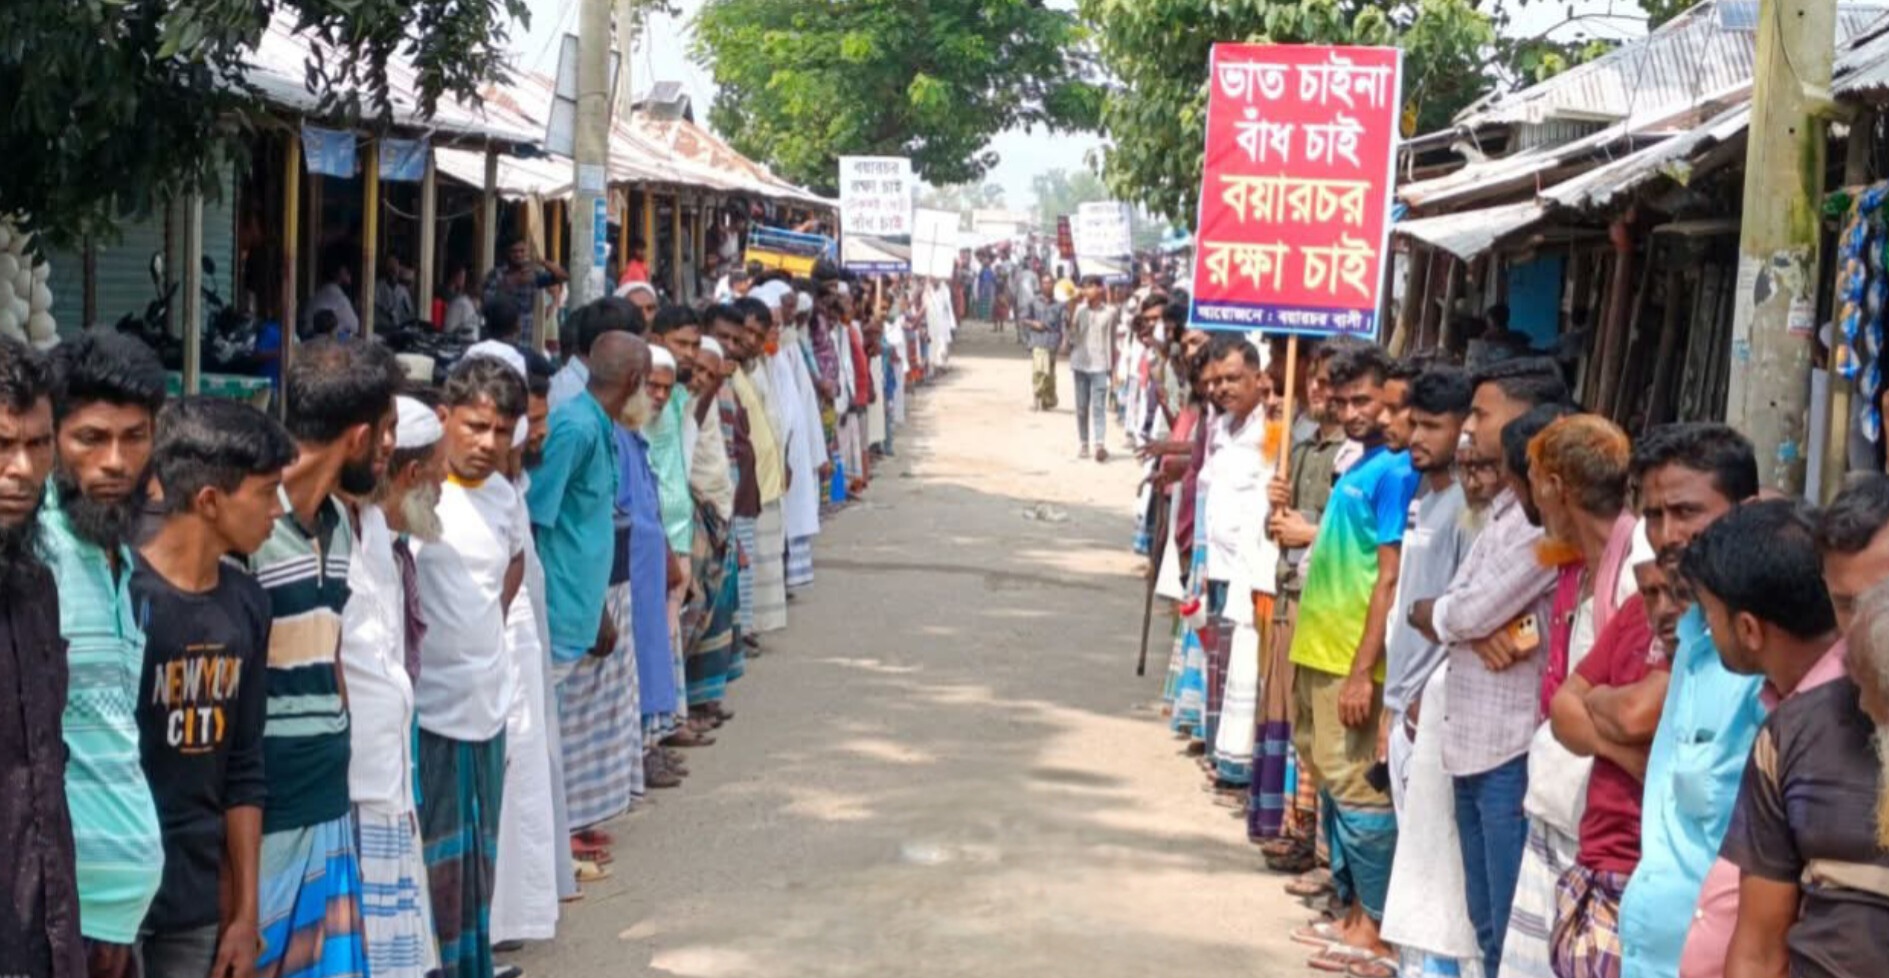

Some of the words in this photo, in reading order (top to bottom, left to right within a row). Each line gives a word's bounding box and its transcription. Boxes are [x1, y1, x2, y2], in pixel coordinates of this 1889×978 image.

[1217, 59, 1288, 101] ভাত
[1296, 51, 1391, 107] চাইনা
[1234, 107, 1294, 163] বাঁধ
[1302, 112, 1364, 167] চাই
[1220, 173, 1371, 227] বয়ারচর
[1204, 240, 1289, 291] রক্ষা
[1301, 231, 1375, 298] চাই
